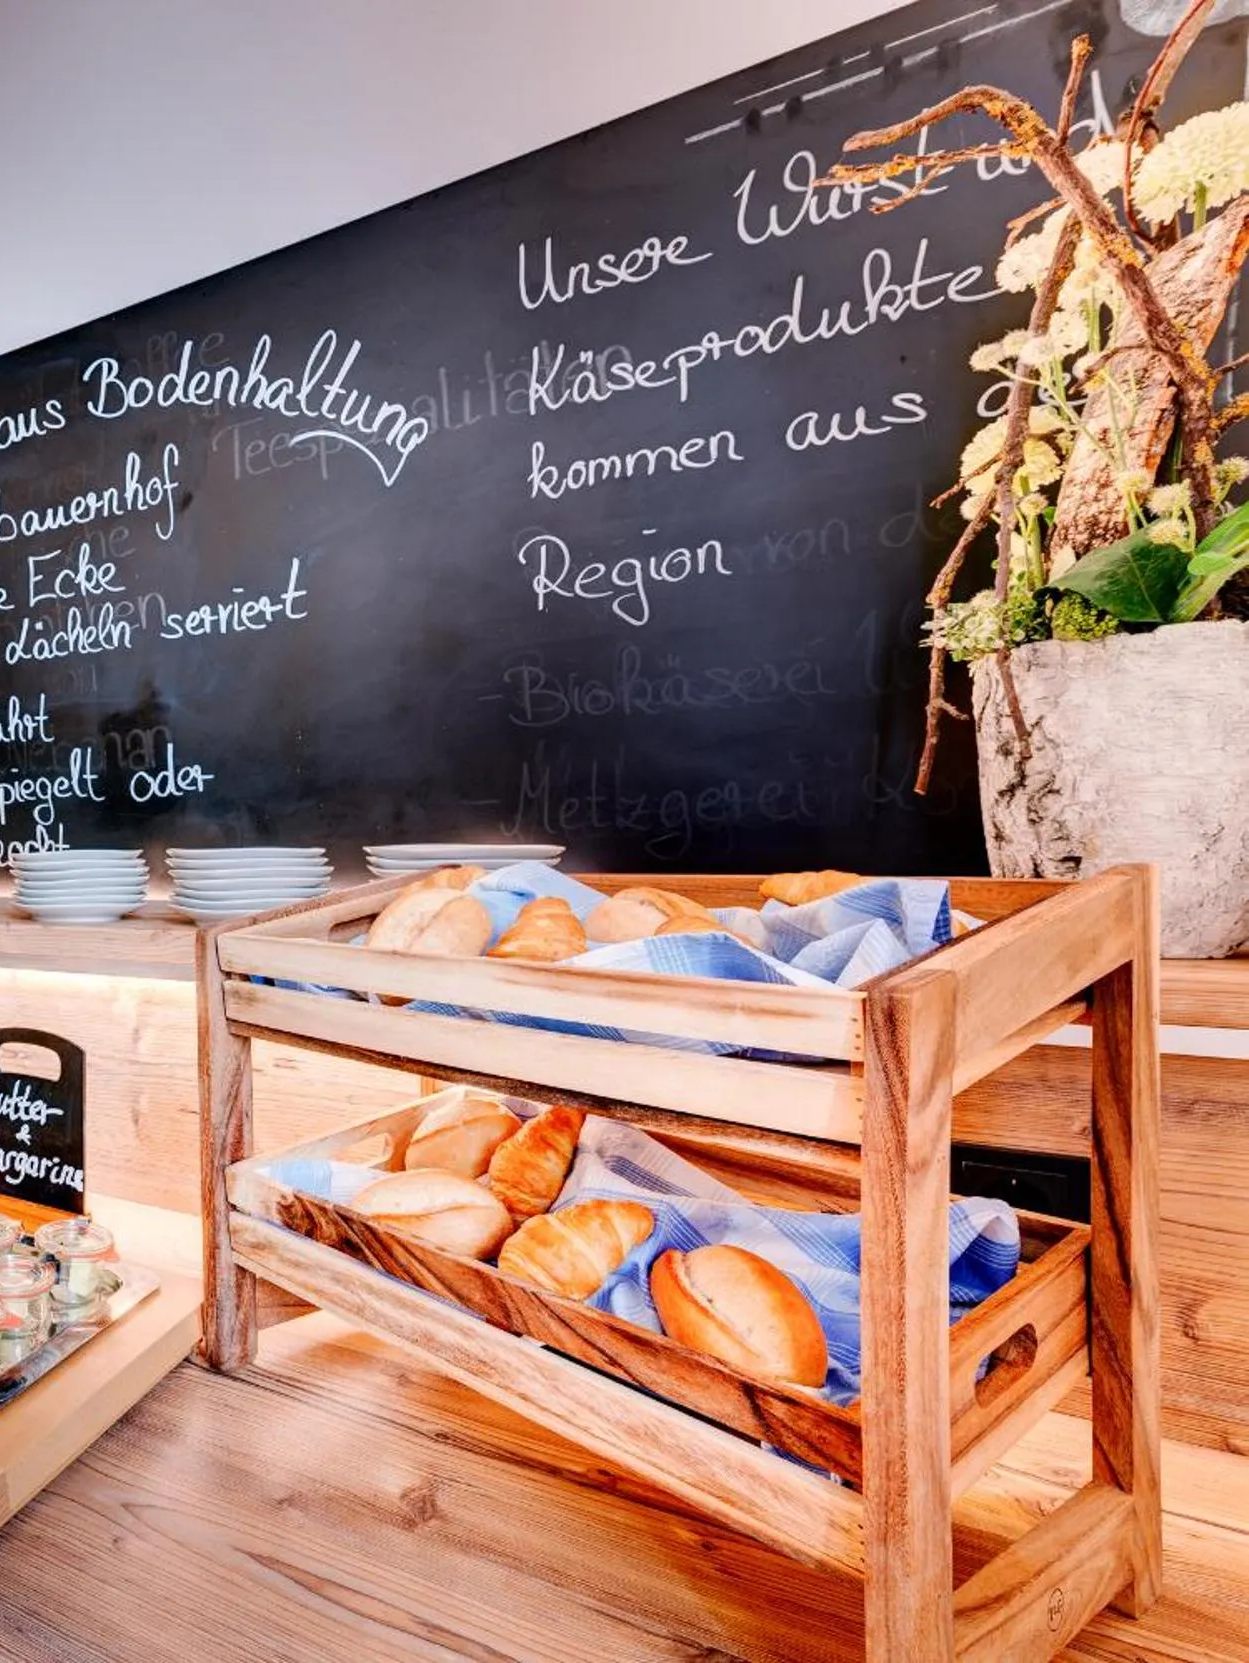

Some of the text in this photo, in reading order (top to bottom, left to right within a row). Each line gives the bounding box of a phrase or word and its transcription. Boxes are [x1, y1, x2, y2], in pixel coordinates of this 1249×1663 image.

[517, 234, 712, 309] Unsere
[528, 237, 1006, 415] Käseprodukte
[83, 329, 429, 487] Bodenhaltung
[528, 429, 744, 499] kommen
[785, 390, 928, 451] aus
[28, 543, 126, 607] Ecke
[516, 528, 732, 626] Region
[6, 602, 131, 665] Lächeln
[130, 743, 214, 802] oder
